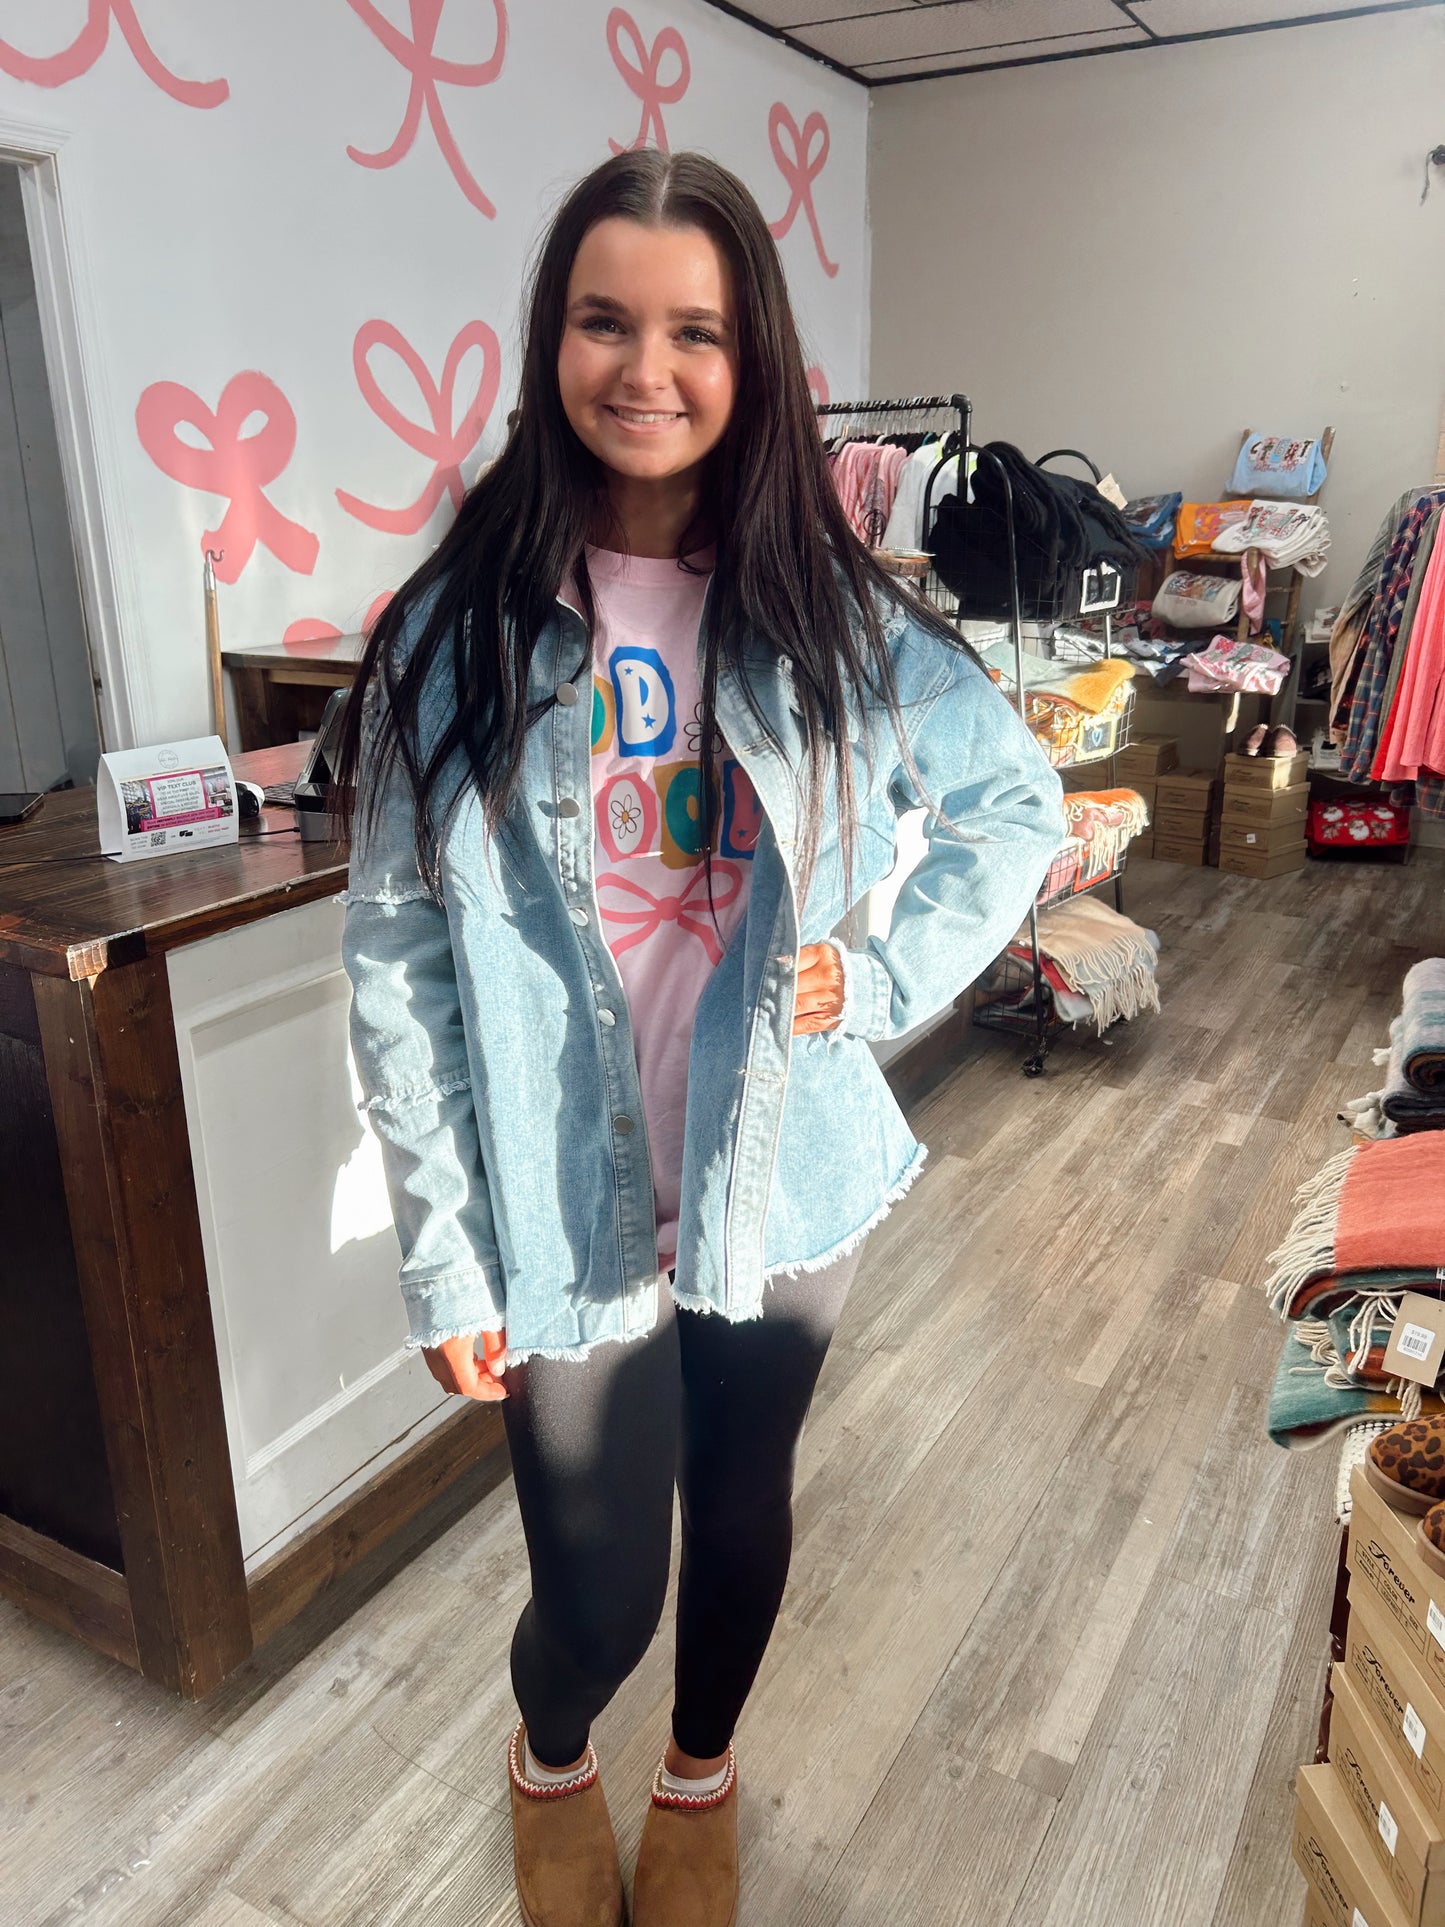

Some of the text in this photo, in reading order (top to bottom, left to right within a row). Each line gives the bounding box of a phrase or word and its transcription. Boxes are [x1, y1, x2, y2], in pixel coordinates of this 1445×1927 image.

[1368, 1540, 1416, 1604] Forever
[1362, 1645, 1404, 1714] Forever
[1345, 1748, 1380, 1818] Forever
[1308, 1836, 1349, 1910] Forever
